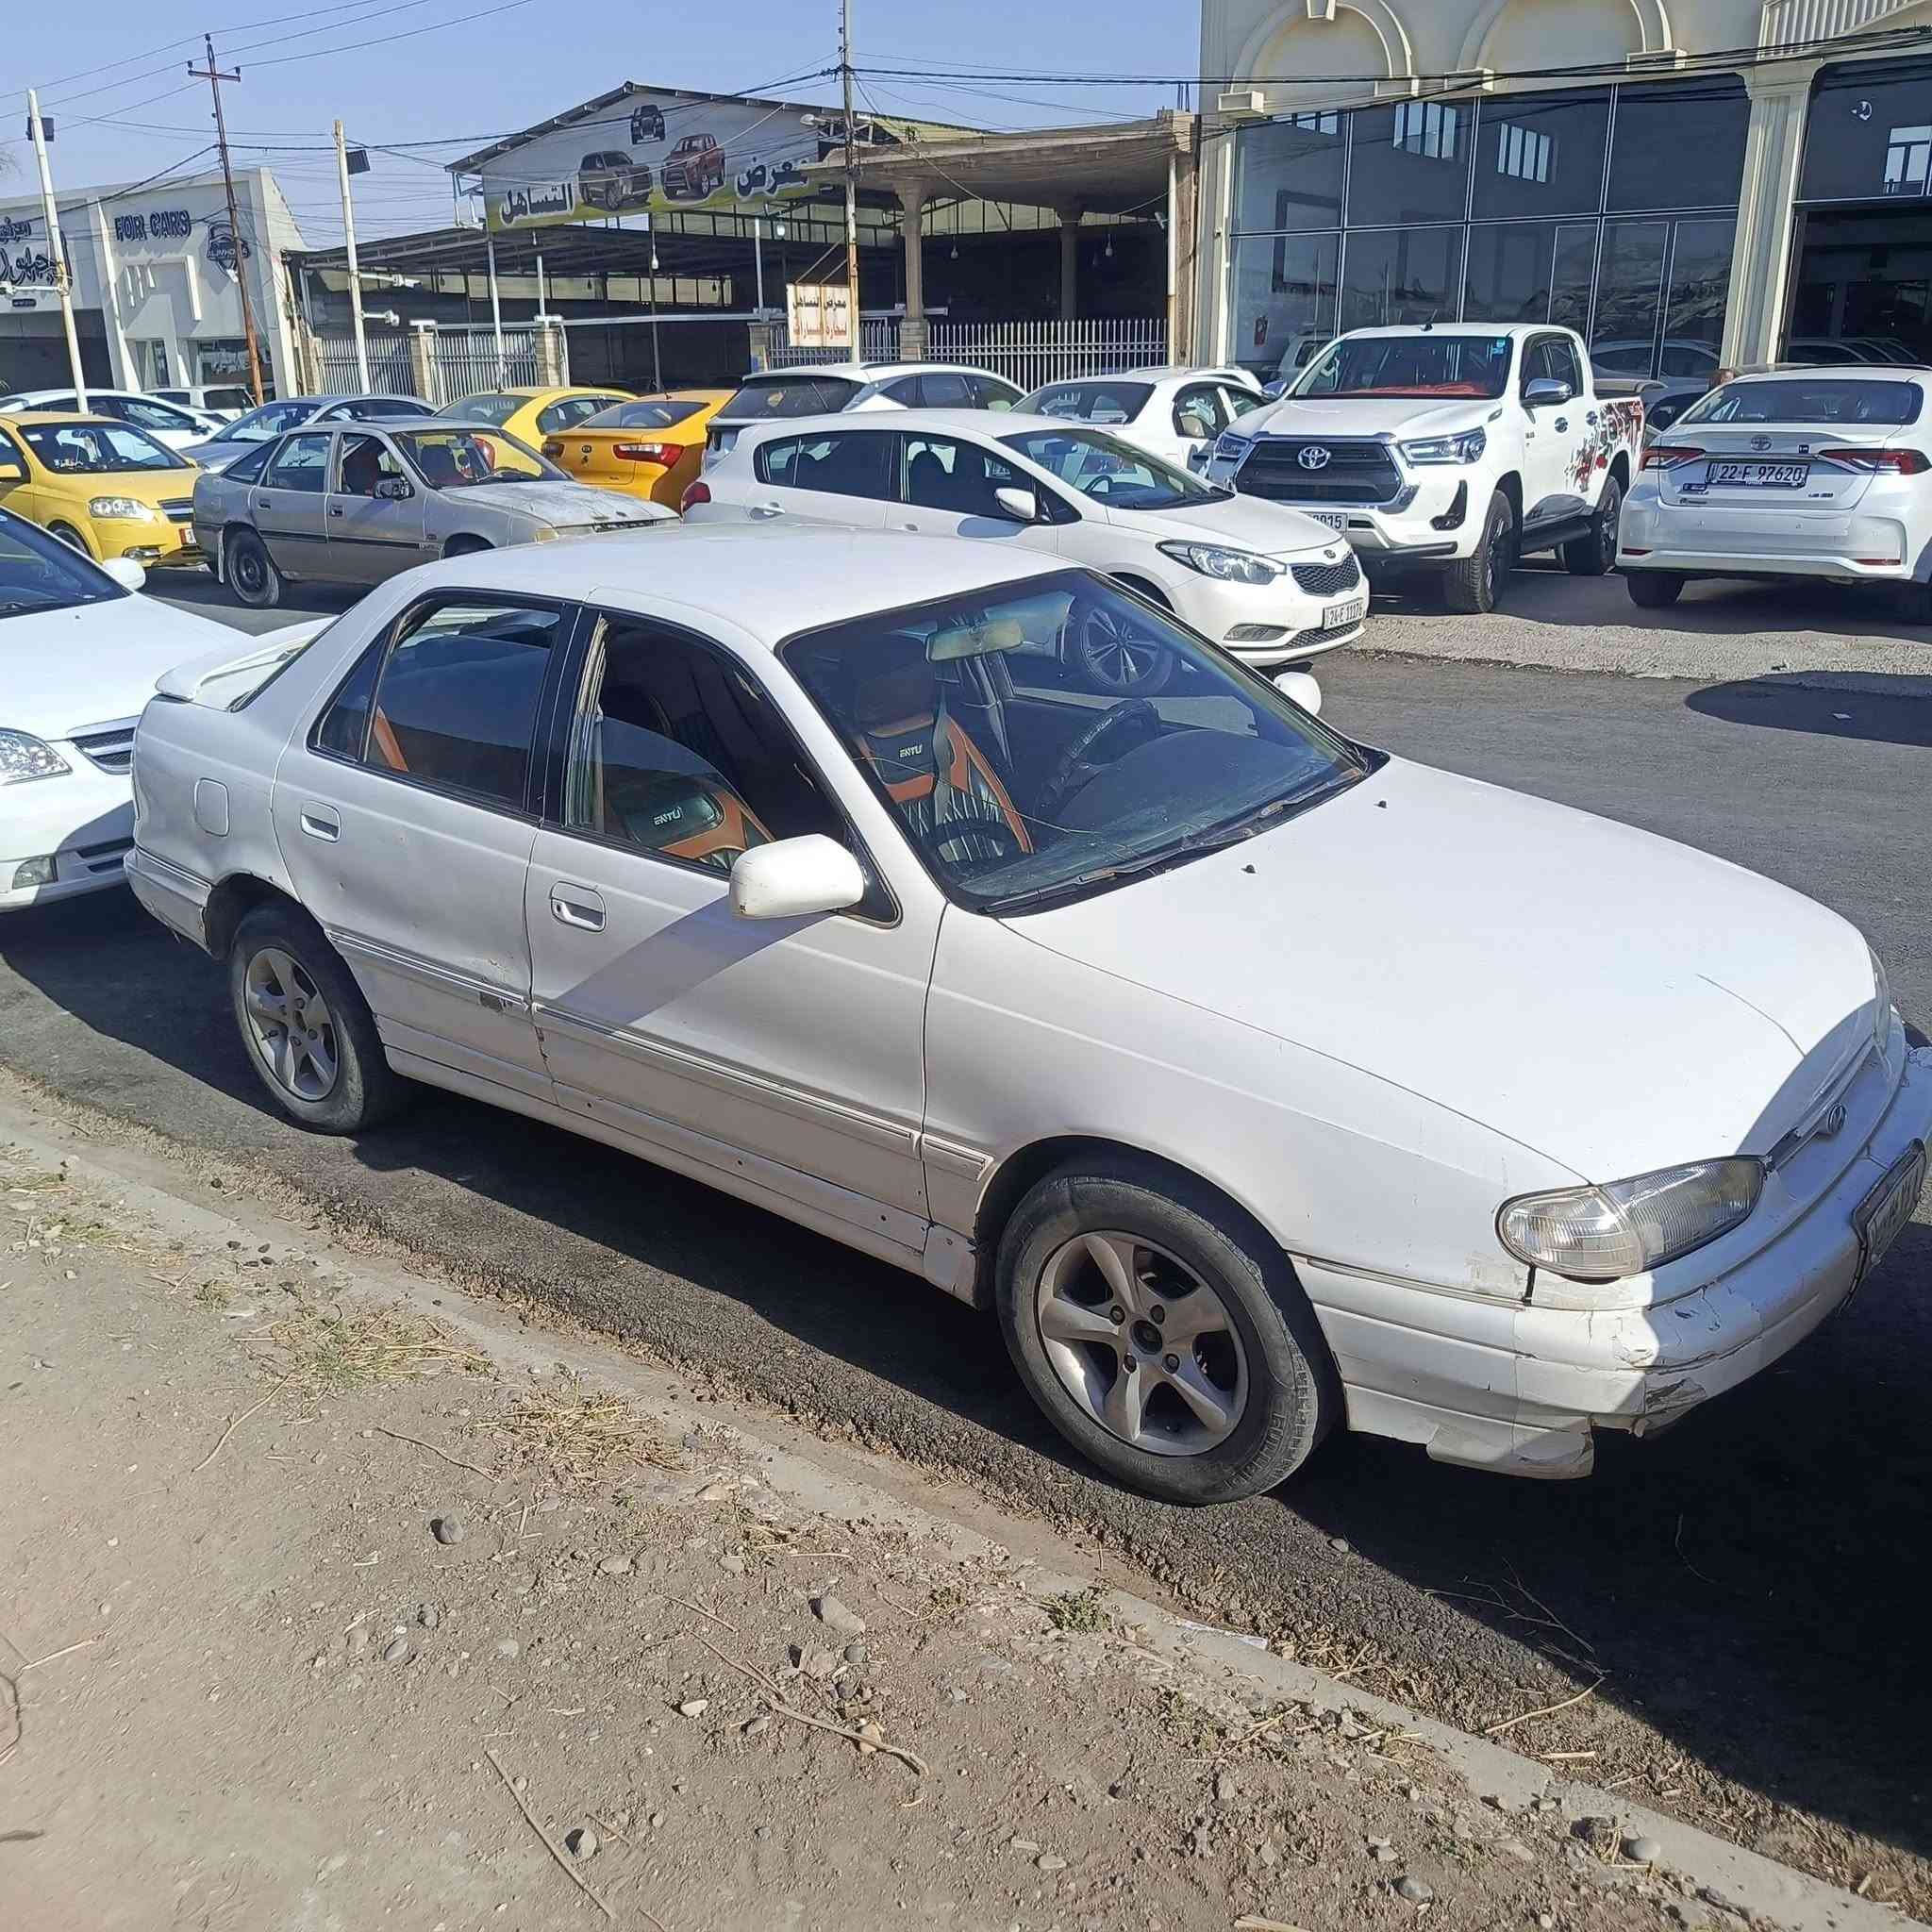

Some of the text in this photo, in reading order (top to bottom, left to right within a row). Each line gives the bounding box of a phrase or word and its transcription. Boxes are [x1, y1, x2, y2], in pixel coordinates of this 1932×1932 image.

[501, 182, 575, 225] التساهل
[114, 209, 192, 242] FOR CARS
[1757, 466, 1803, 481] 97620
